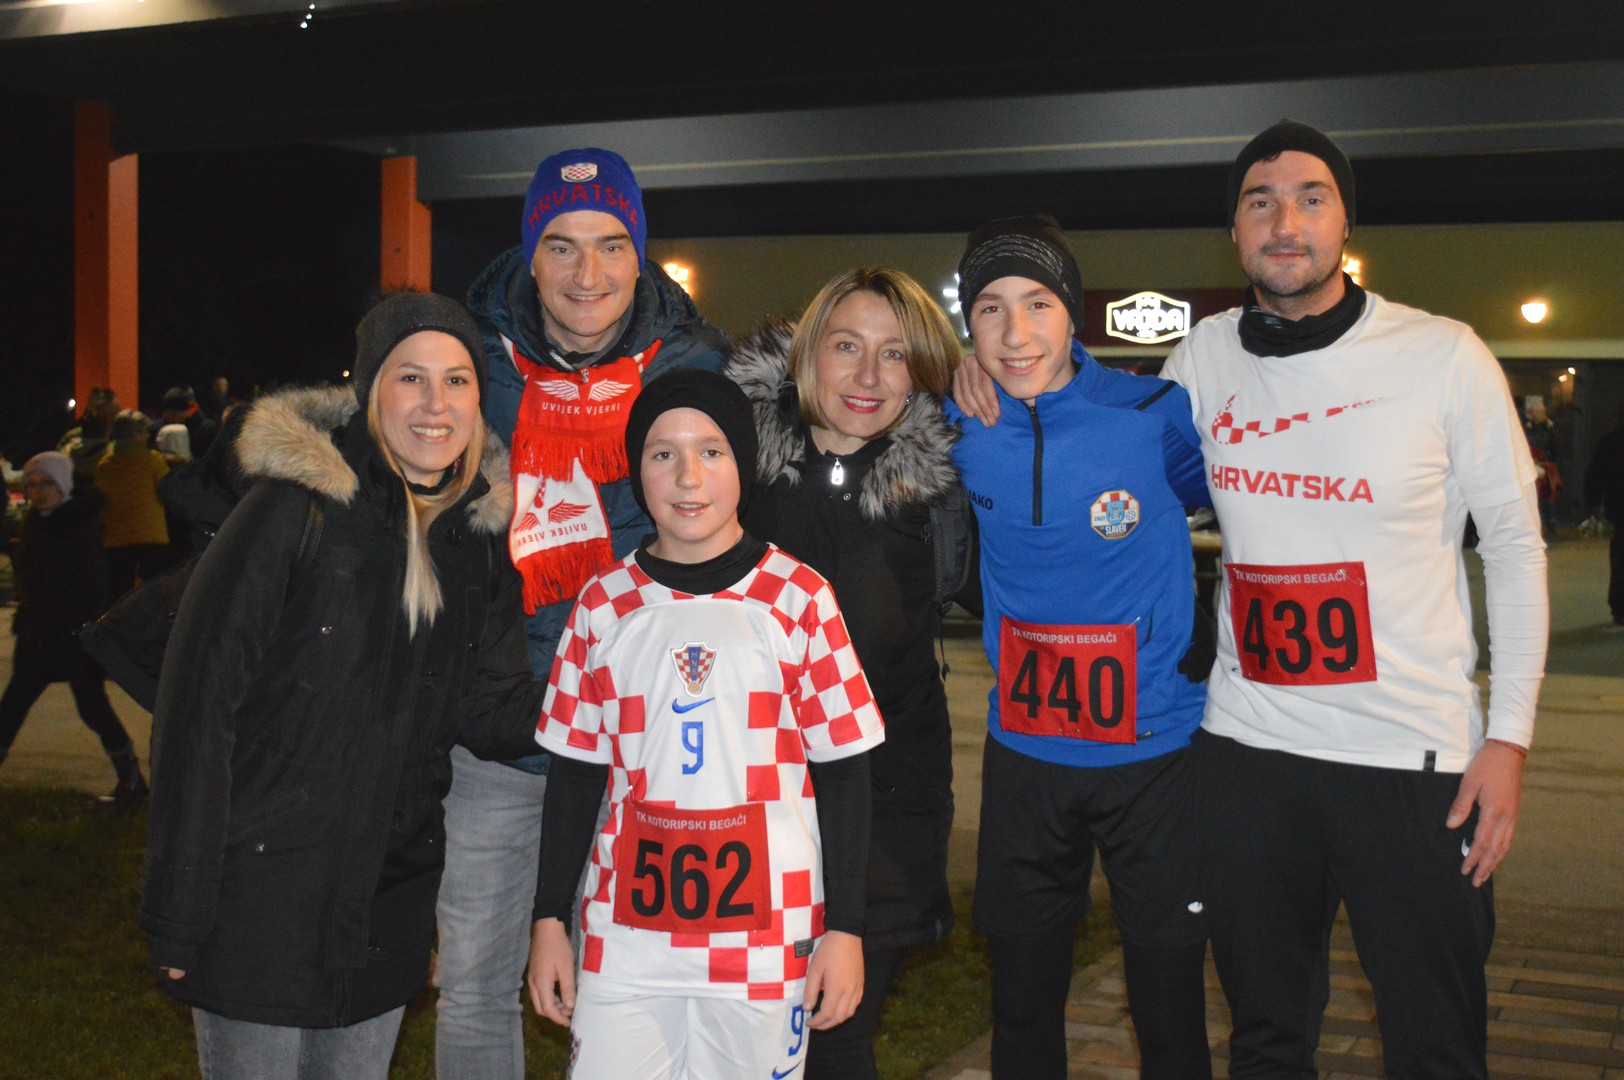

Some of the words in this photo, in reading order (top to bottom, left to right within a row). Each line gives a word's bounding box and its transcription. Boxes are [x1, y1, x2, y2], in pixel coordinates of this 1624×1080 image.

[528, 183, 638, 232] HRVATSKA
[542, 401, 580, 414] UVIJEK
[586, 402, 620, 415] VJERNI
[1211, 464, 1374, 503] HRVATSKA
[1235, 569, 1245, 581] TK
[1246, 572, 1300, 584] KOTORIPSKI
[1077, 632, 1116, 644] BEGAČI
[1242, 597, 1358, 674] 439
[1010, 649, 1124, 728] 440
[682, 721, 704, 775] 9
[635, 811, 646, 823] TK
[648, 815, 706, 830] KOTORIPSKI
[709, 814, 747, 830] BEGAČI
[631, 838, 754, 920] 562
[788, 1003, 804, 1056] 9
